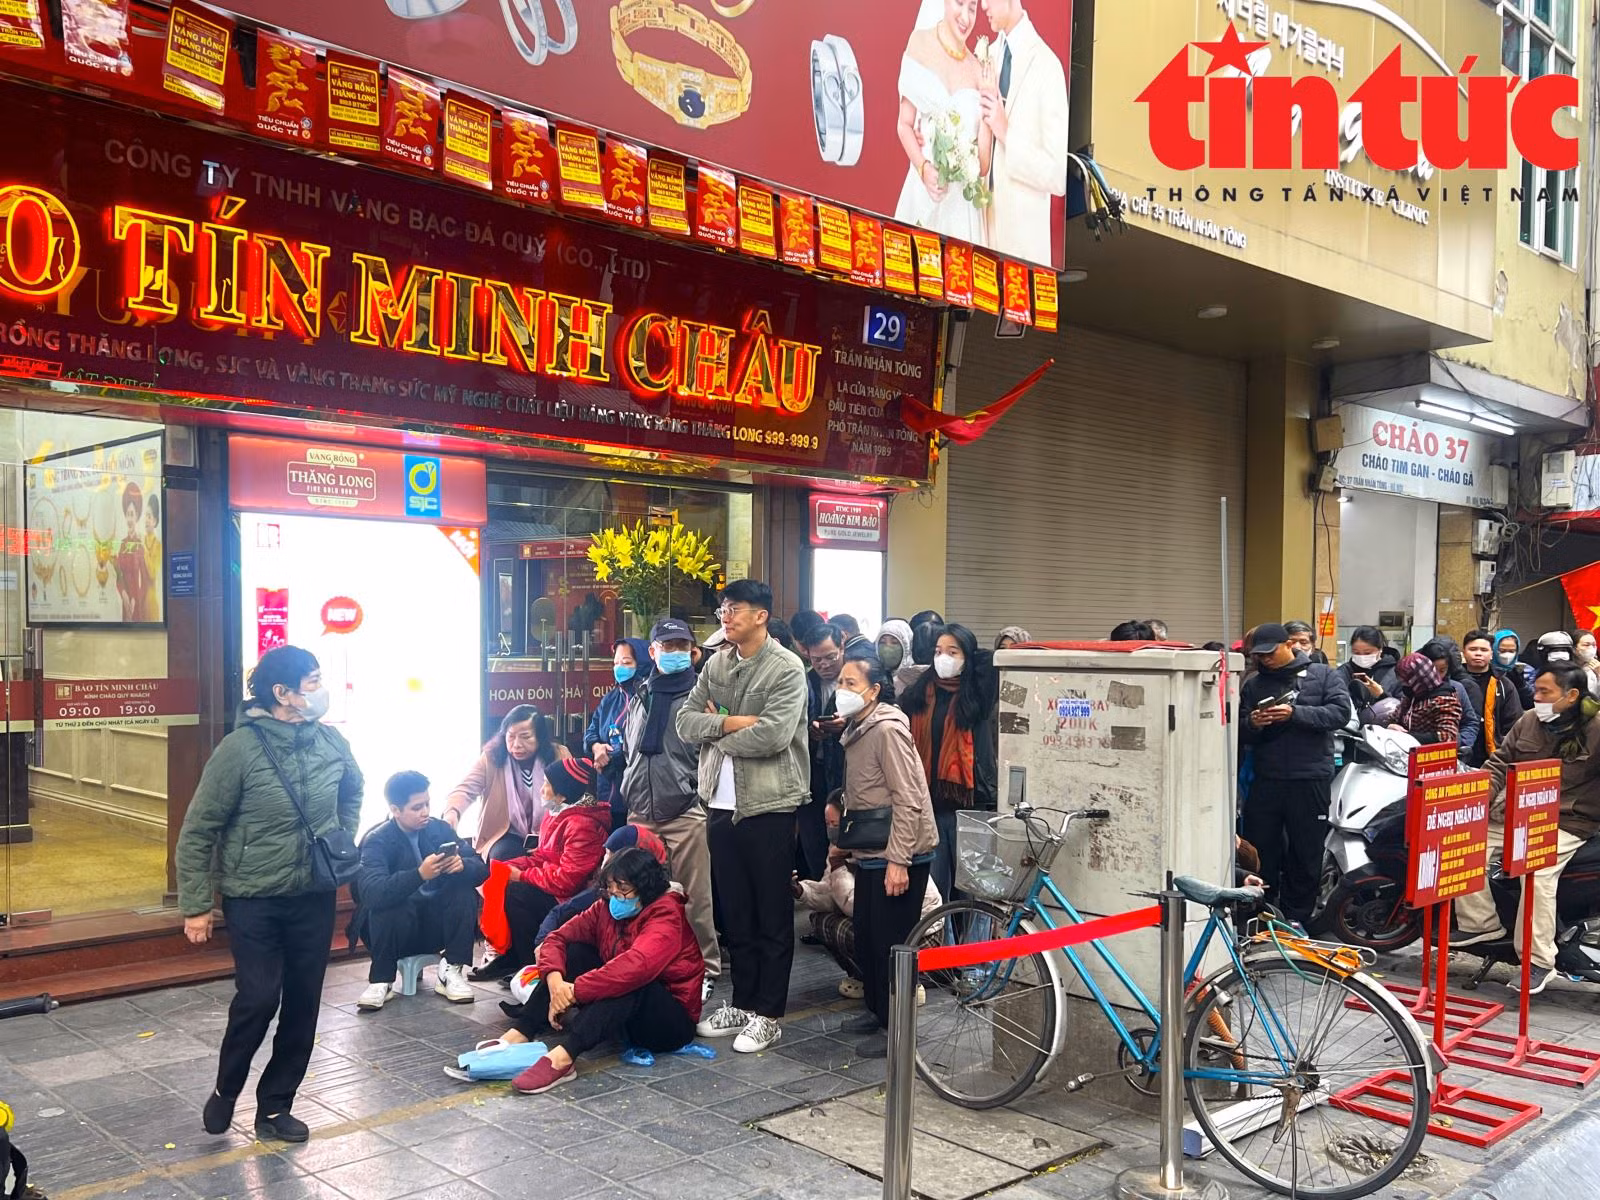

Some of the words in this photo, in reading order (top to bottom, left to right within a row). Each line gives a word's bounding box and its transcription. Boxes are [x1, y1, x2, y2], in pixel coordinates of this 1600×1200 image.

[357, 94, 377, 103] LONG
[257, 122, 284, 133] QUỐC
[286, 128, 298, 137] TẾ
[385, 145, 408, 157] QUỐC
[410, 152, 421, 161] TẾ
[104, 138, 192, 179] CÔNG
[202, 160, 240, 189] TY
[251, 171, 321, 208] TNHH
[409, 208, 457, 240] BẠC
[465, 219, 496, 247] ĐÁ
[505, 186, 527, 195] QUỐC
[529, 190, 538, 198] TẾ
[1153, 203, 1165, 220] 35
[1222, 226, 1247, 248] TÔNG
[112, 195, 331, 338] TÍN
[350, 253, 613, 382] MINH
[625, 310, 822, 413] CHÂU
[873, 312, 901, 342] 29
[864, 355, 892, 373] NHÂN
[895, 360, 922, 379] TÔNG
[67, 332, 140, 361] THĂNG
[216, 355, 250, 376] SJC
[339, 372, 396, 396] TRANG
[733, 426, 763, 443] LONG
[896, 428, 918, 442] TÔNG
[1372, 421, 1439, 457] CHÁO
[1444, 436, 1471, 464] 37
[874, 444, 892, 457] 1989
[1362, 453, 1388, 470] CHÁO
[1391, 459, 1408, 475] TIM
[1410, 462, 1429, 478] GAN
[1437, 467, 1460, 485] CHÁO
[289, 470, 336, 485] THĂNG
[339, 475, 374, 489] LONG
[846, 514, 861, 526] KIM
[327, 608, 357, 622] NEW
[74, 684, 93, 692] BẢO
[94, 683, 109, 692] TÍN
[111, 683, 134, 691] MINH
[135, 682, 159, 691] CHÂU
[489, 688, 524, 701] HOAN
[527, 686, 553, 700] ĐÓN
[59, 707, 101, 717] 09:00
[119, 704, 156, 715] 19:00
[1426, 806, 1437, 831] ĐỀ
[1437, 810, 1454, 831] NGHỊ
[1454, 804, 1473, 826] NHÂN
[1473, 801, 1486, 822] DÂN
